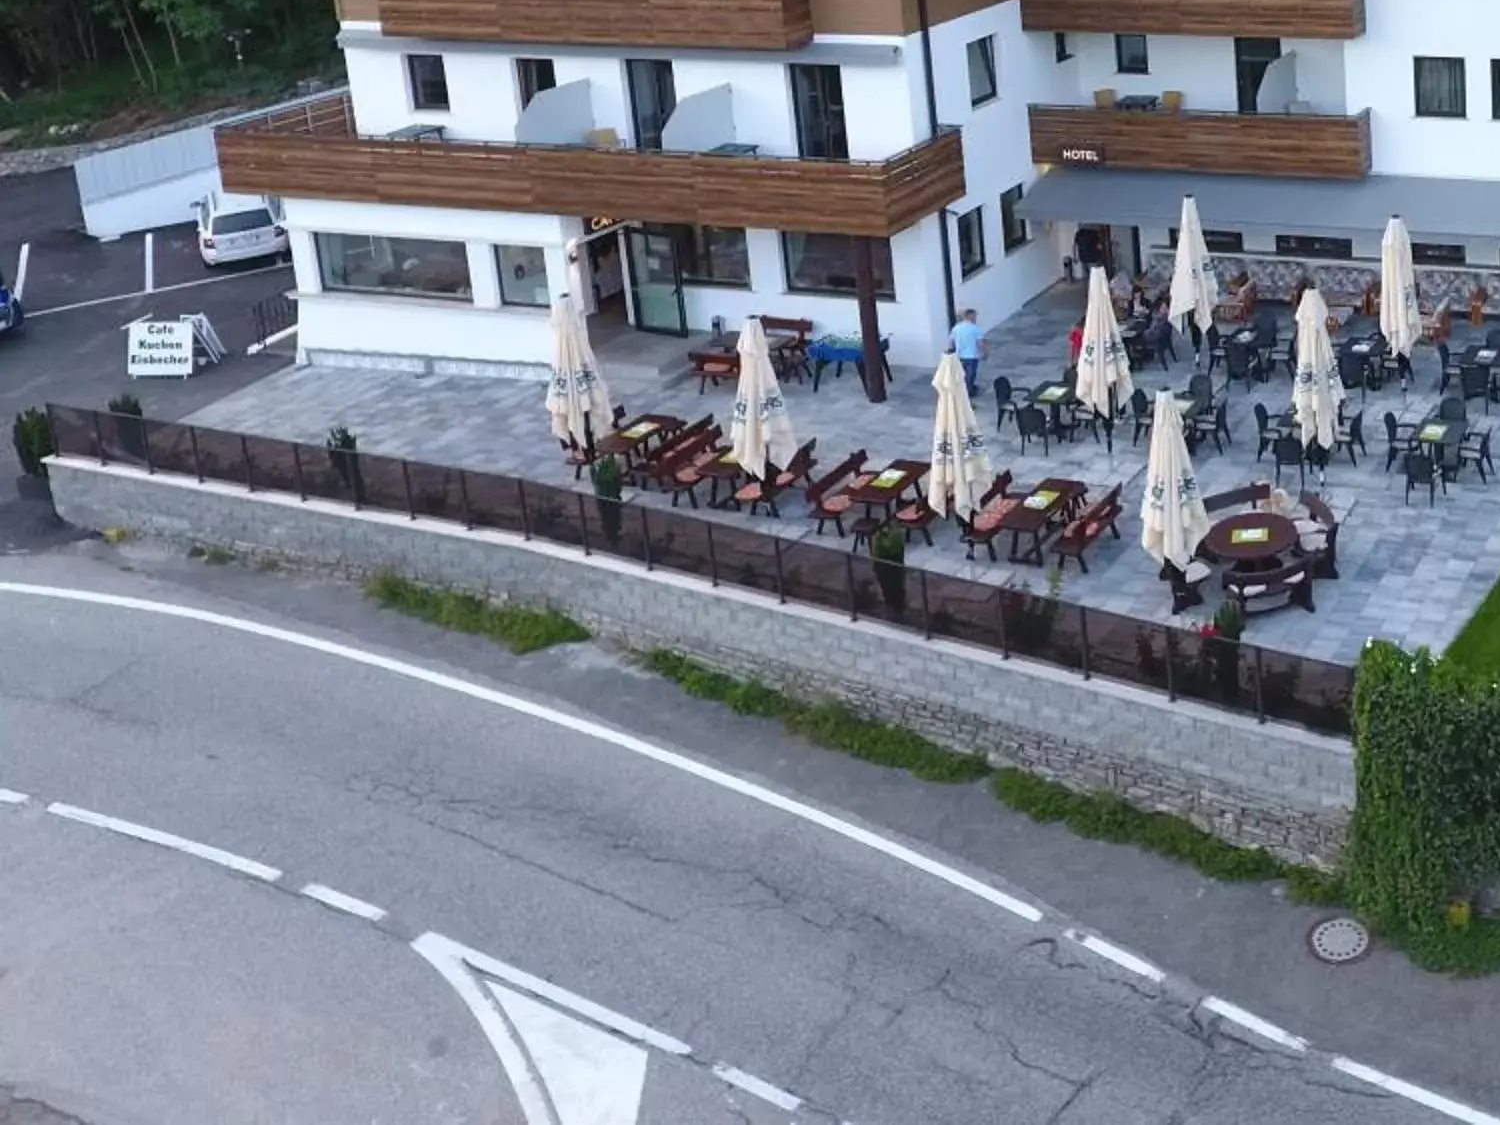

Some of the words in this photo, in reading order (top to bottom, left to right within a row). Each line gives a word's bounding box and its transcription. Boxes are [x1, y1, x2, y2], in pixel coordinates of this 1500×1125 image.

[1062, 149, 1099, 161] HOTEL
[138, 339, 183, 350] Kuchen
[130, 354, 190, 365] Eisbecher
